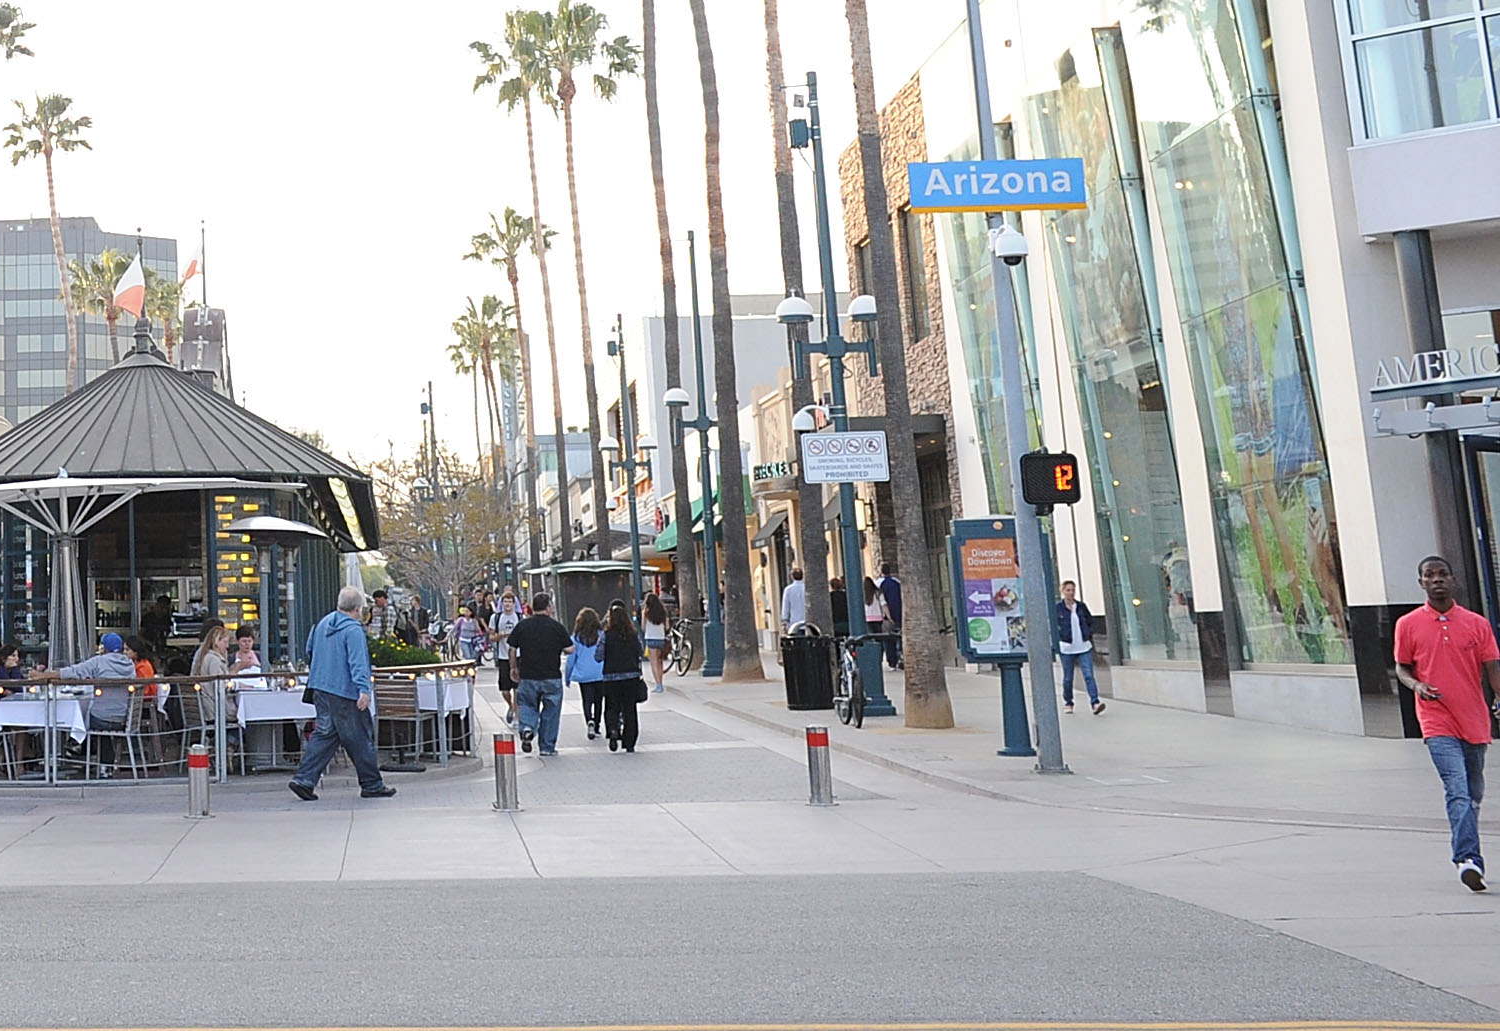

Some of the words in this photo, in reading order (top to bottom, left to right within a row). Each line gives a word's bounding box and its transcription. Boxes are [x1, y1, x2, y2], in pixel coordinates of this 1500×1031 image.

[924, 166, 1071, 196] Arizona
[1374, 346, 1500, 387] AMERIC
[1055, 464, 1073, 490] 12
[967, 557, 1012, 566] Downtown
[971, 549, 1006, 558] Discover
